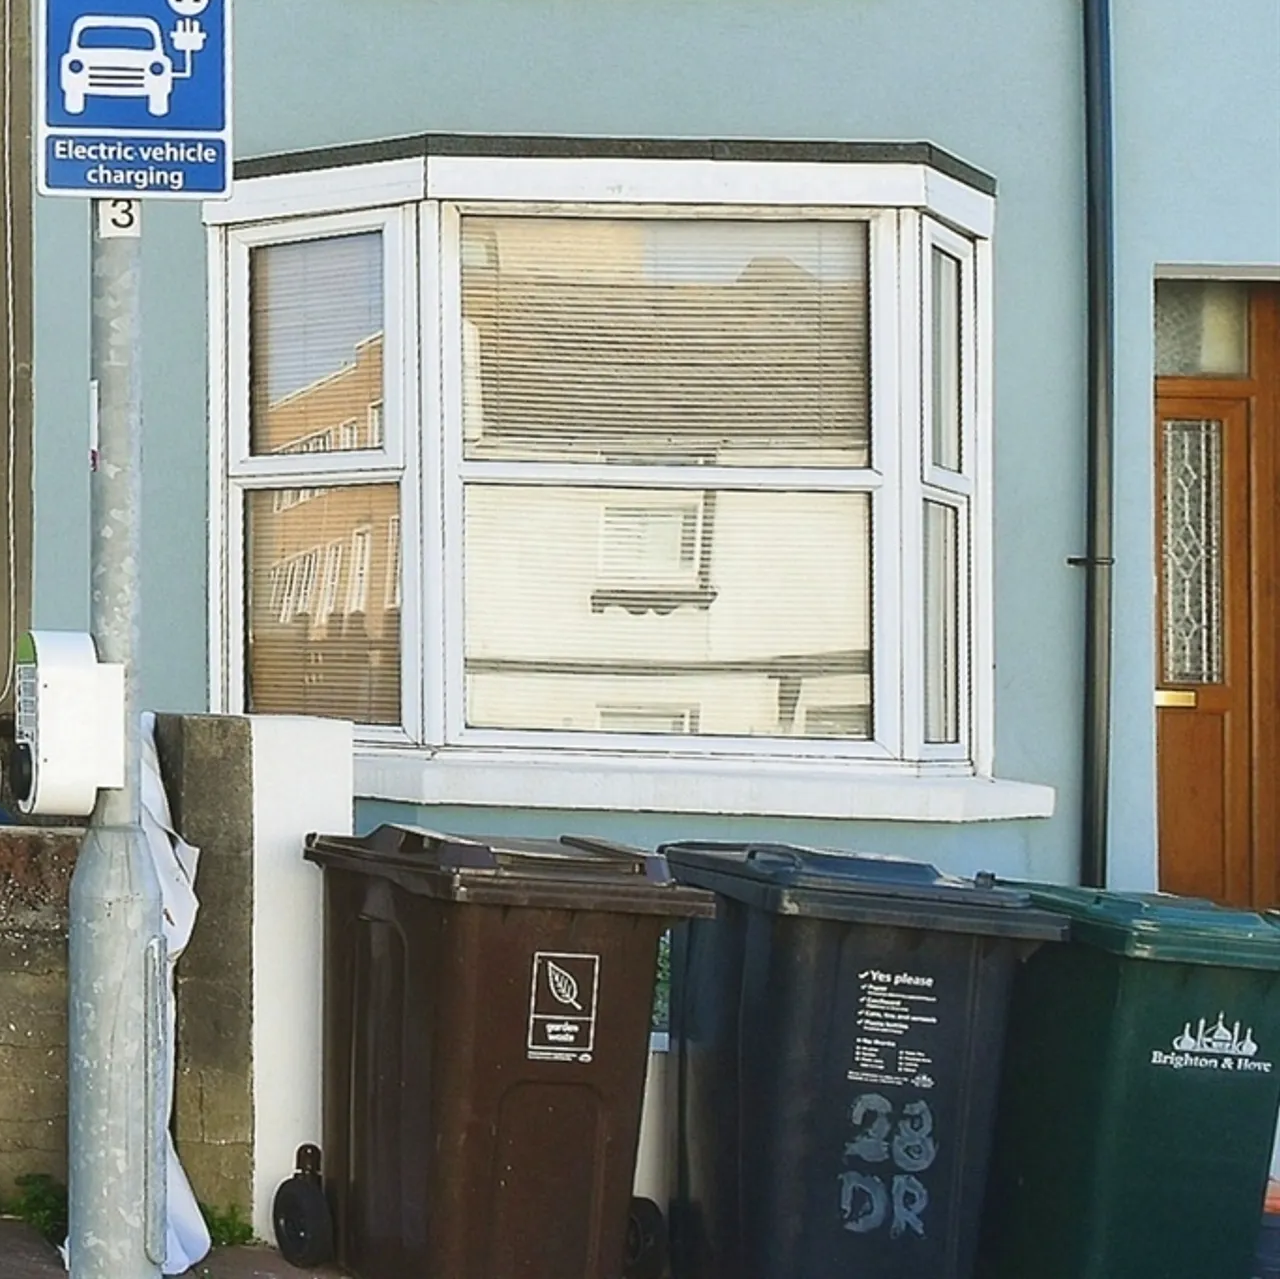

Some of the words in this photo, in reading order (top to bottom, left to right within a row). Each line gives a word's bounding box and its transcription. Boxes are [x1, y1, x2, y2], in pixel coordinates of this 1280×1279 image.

[54, 139, 134, 160] Electric
[139, 141, 217, 163] vehicle
[86, 164, 183, 189] charging
[111, 199, 134, 228] 3
[870, 970, 892, 983] Yes
[893, 972, 934, 988] please
[1151, 1050, 1218, 1069] Brighton
[1221, 1057, 1234, 1070] &
[1237, 1058, 1272, 1073] Hove
[838, 1171, 928, 1239] DR
